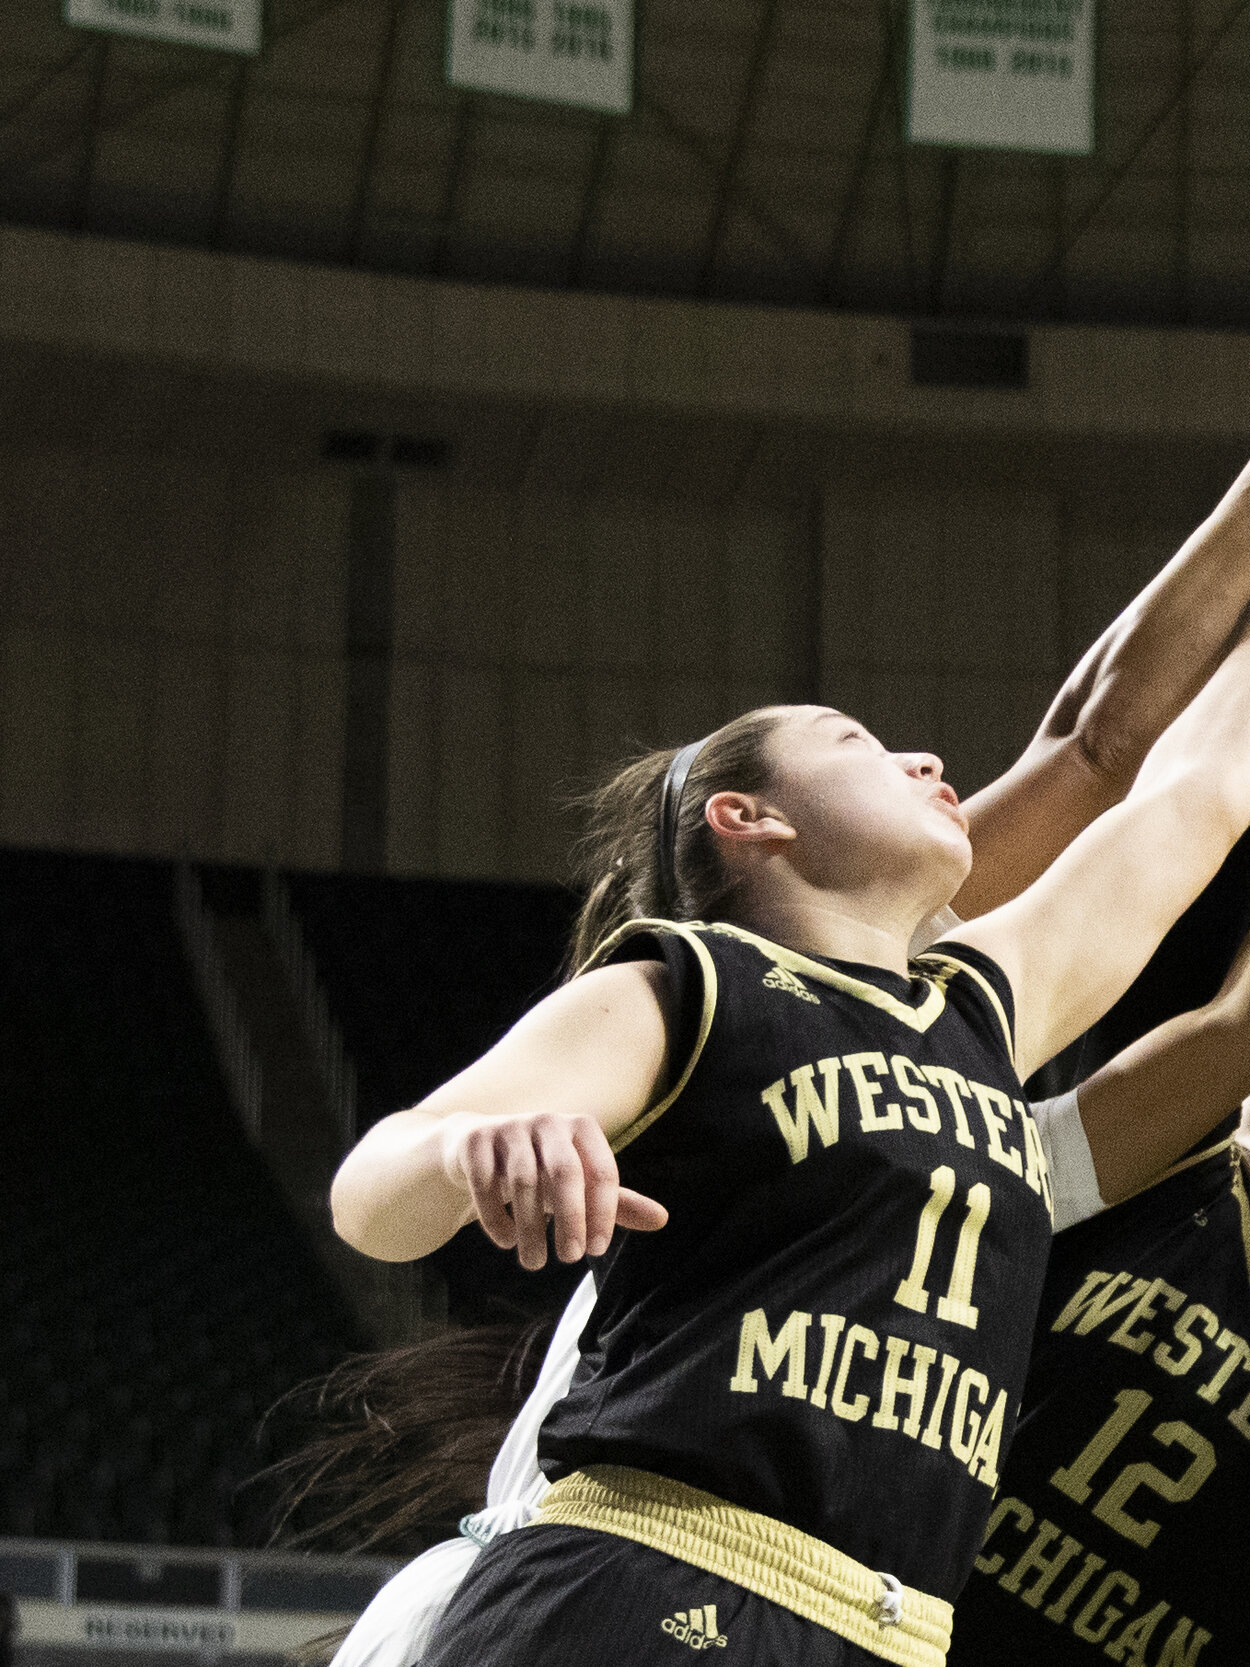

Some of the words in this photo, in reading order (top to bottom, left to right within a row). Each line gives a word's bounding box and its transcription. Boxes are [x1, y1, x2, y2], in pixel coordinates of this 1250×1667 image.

[761, 1051, 1054, 1216] WESTER
[893, 1165, 991, 1330] 11
[730, 1308, 1008, 1490] MICHIGA
[1049, 1389, 1216, 1548] 12
[661, 1618, 728, 1650] adidas
